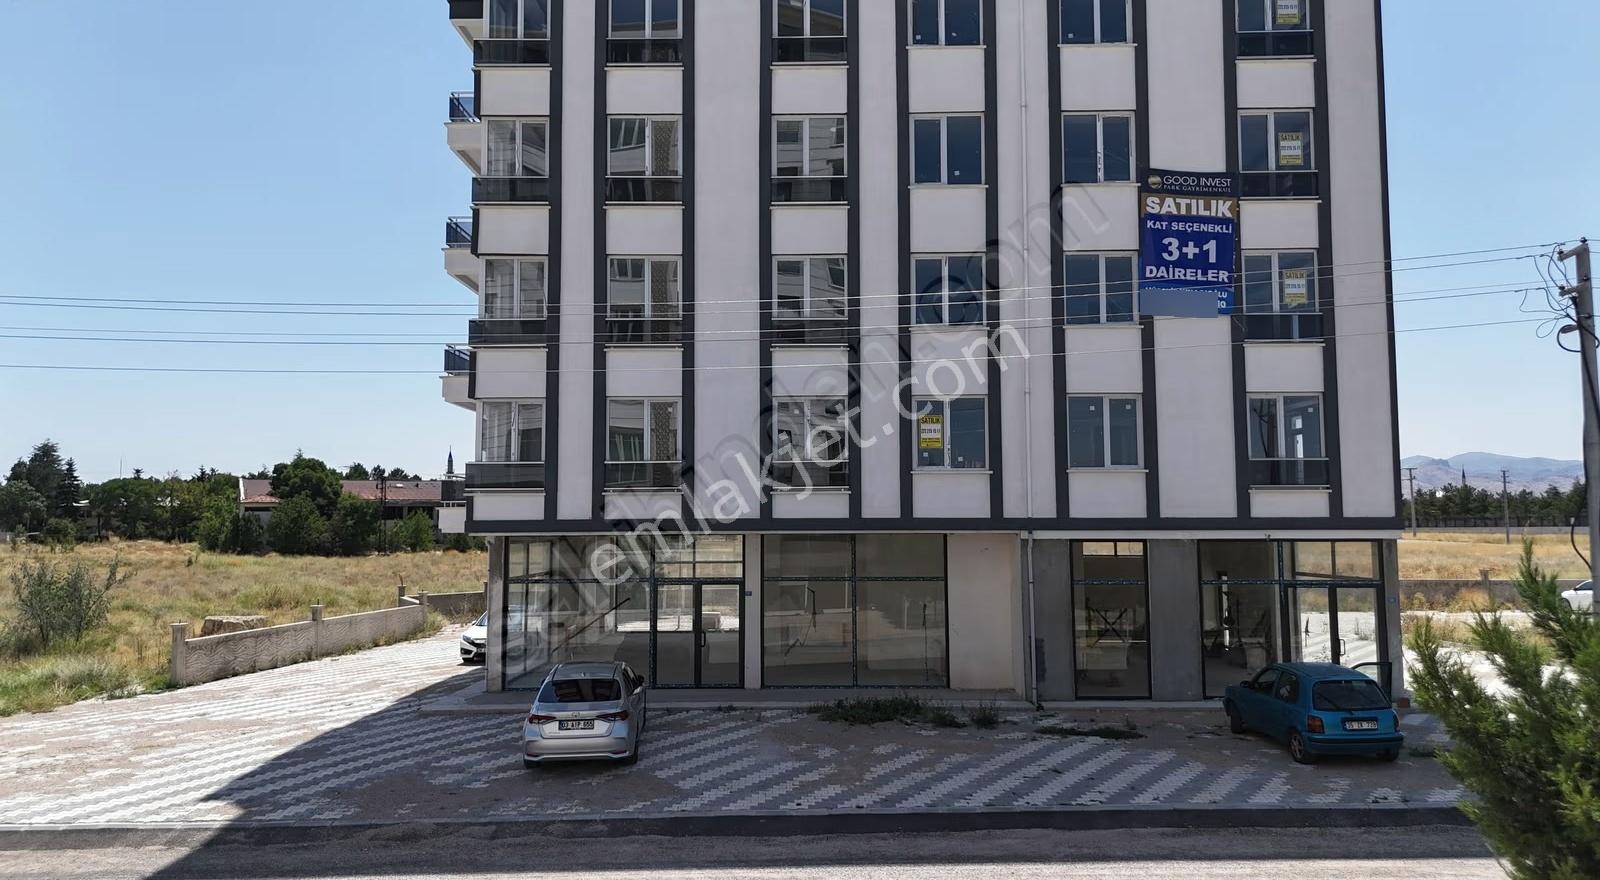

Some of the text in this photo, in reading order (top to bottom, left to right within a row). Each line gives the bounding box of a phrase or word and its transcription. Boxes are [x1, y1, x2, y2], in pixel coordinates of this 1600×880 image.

[1163, 176, 1232, 187] GOOD INVEST
[1146, 197, 1232, 217] SATILIK
[1146, 220, 1232, 233] KAT SEÇENEKLİ
[1161, 237, 1217, 263] 3+1
[1145, 265, 1229, 282] DAİRELER
[920, 416, 941, 424] SATILIK
